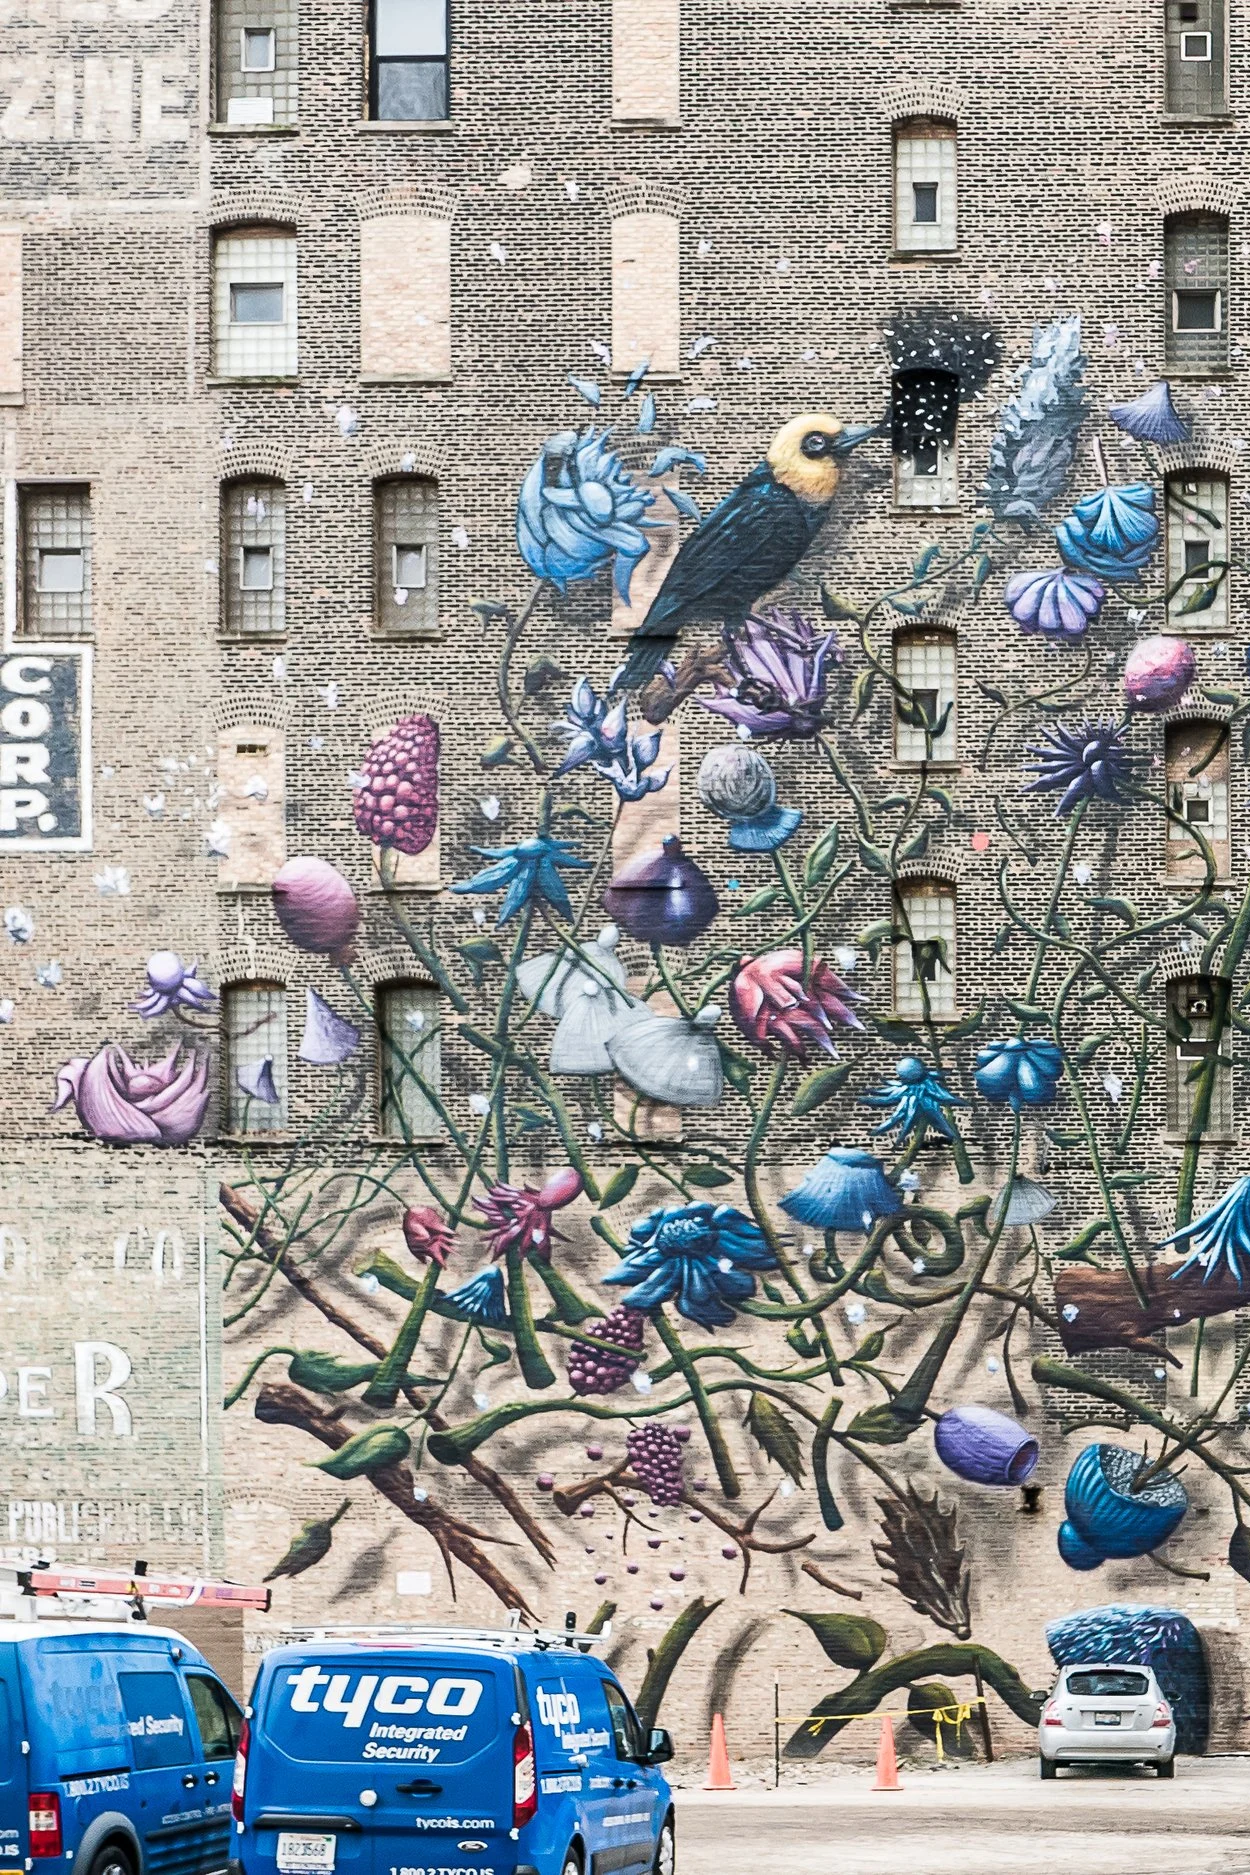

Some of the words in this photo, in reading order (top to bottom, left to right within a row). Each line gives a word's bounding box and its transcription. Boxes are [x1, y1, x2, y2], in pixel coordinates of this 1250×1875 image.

[286, 1665, 484, 1728] tyco
[536, 1685, 581, 1738] tyco
[368, 1722, 469, 1743] Integrated
[362, 1741, 441, 1764] Security
[415, 1816, 495, 1830] tycois.com
